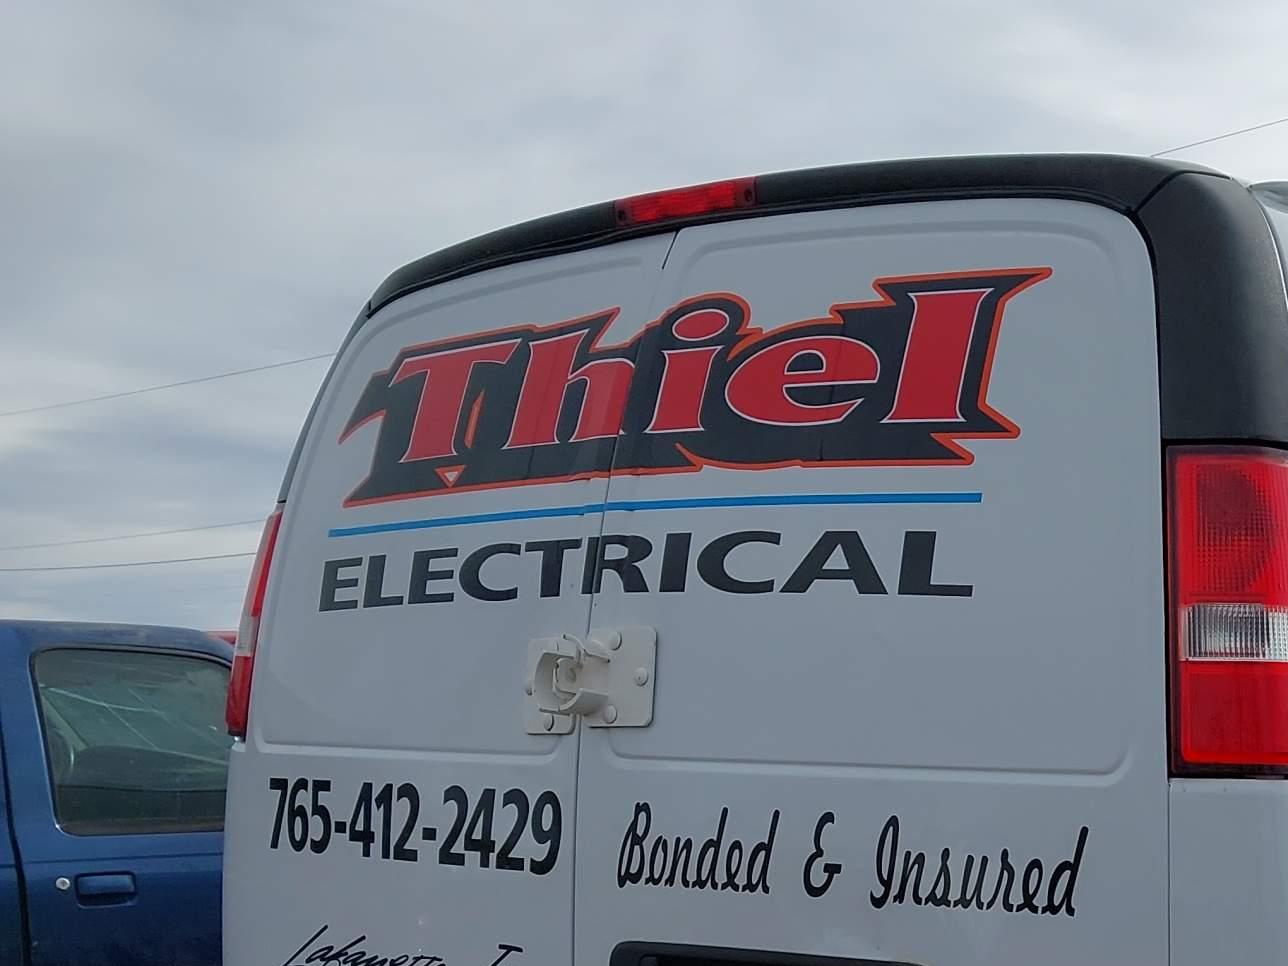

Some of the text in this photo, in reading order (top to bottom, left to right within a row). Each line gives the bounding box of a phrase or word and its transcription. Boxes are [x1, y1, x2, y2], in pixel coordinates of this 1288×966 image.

[386, 286, 997, 465] Thiel
[318, 530, 974, 613] ELECTRICAL
[268, 777, 563, 876] 765-412-2429
[616, 800, 1089, 918] Bonded & Insured
